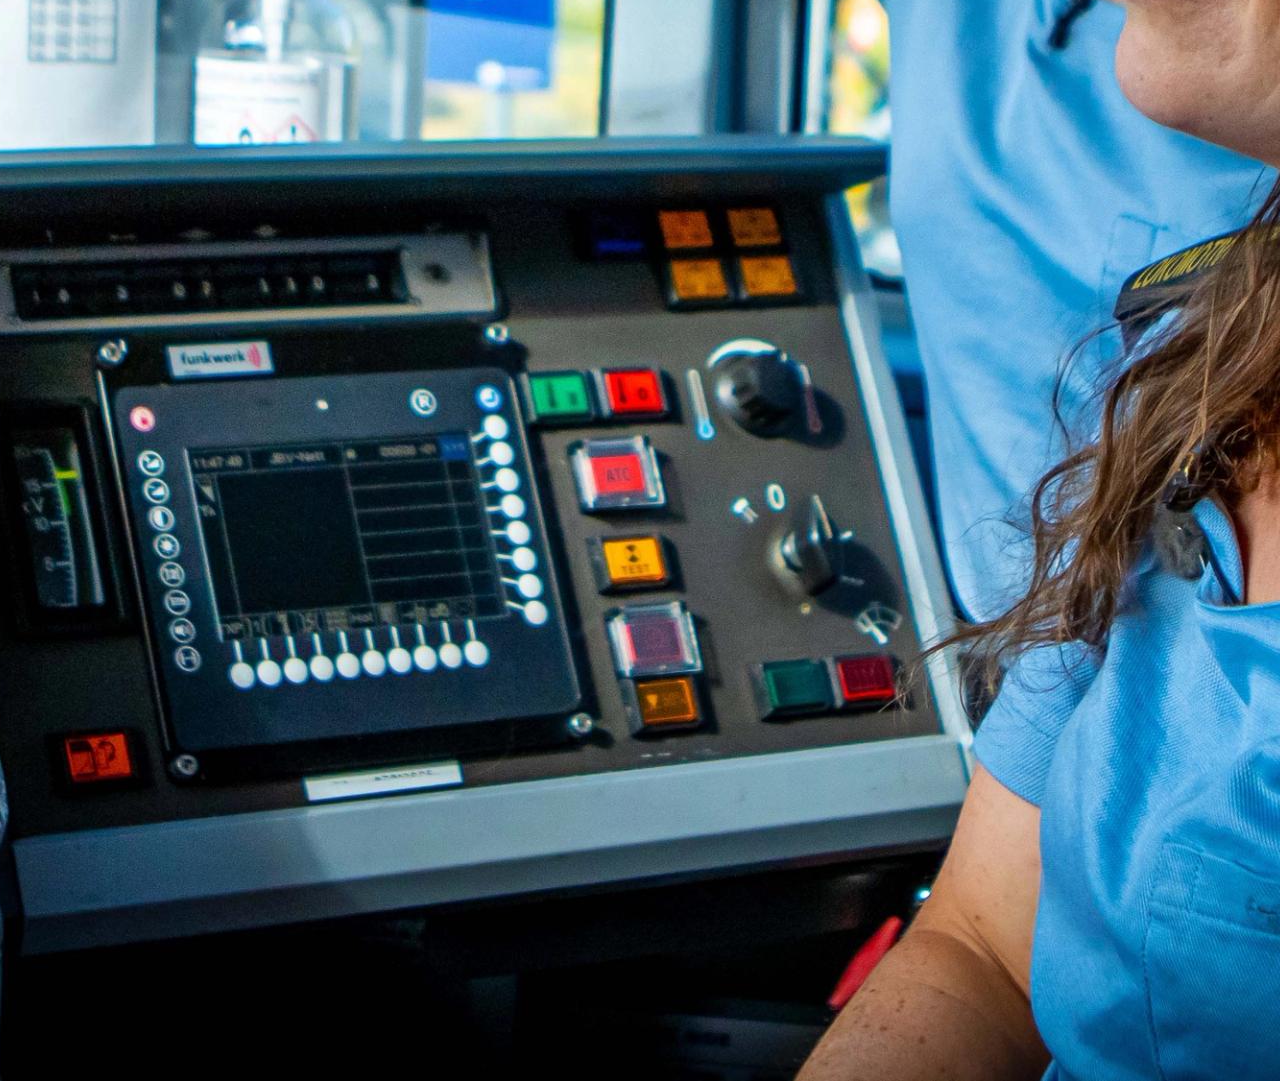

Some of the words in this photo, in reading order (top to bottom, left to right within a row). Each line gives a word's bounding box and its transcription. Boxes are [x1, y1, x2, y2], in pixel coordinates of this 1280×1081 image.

[181, 348, 246, 365] funkwerk
[606, 466, 632, 482] ATC
[620, 563, 650, 575] TEST
